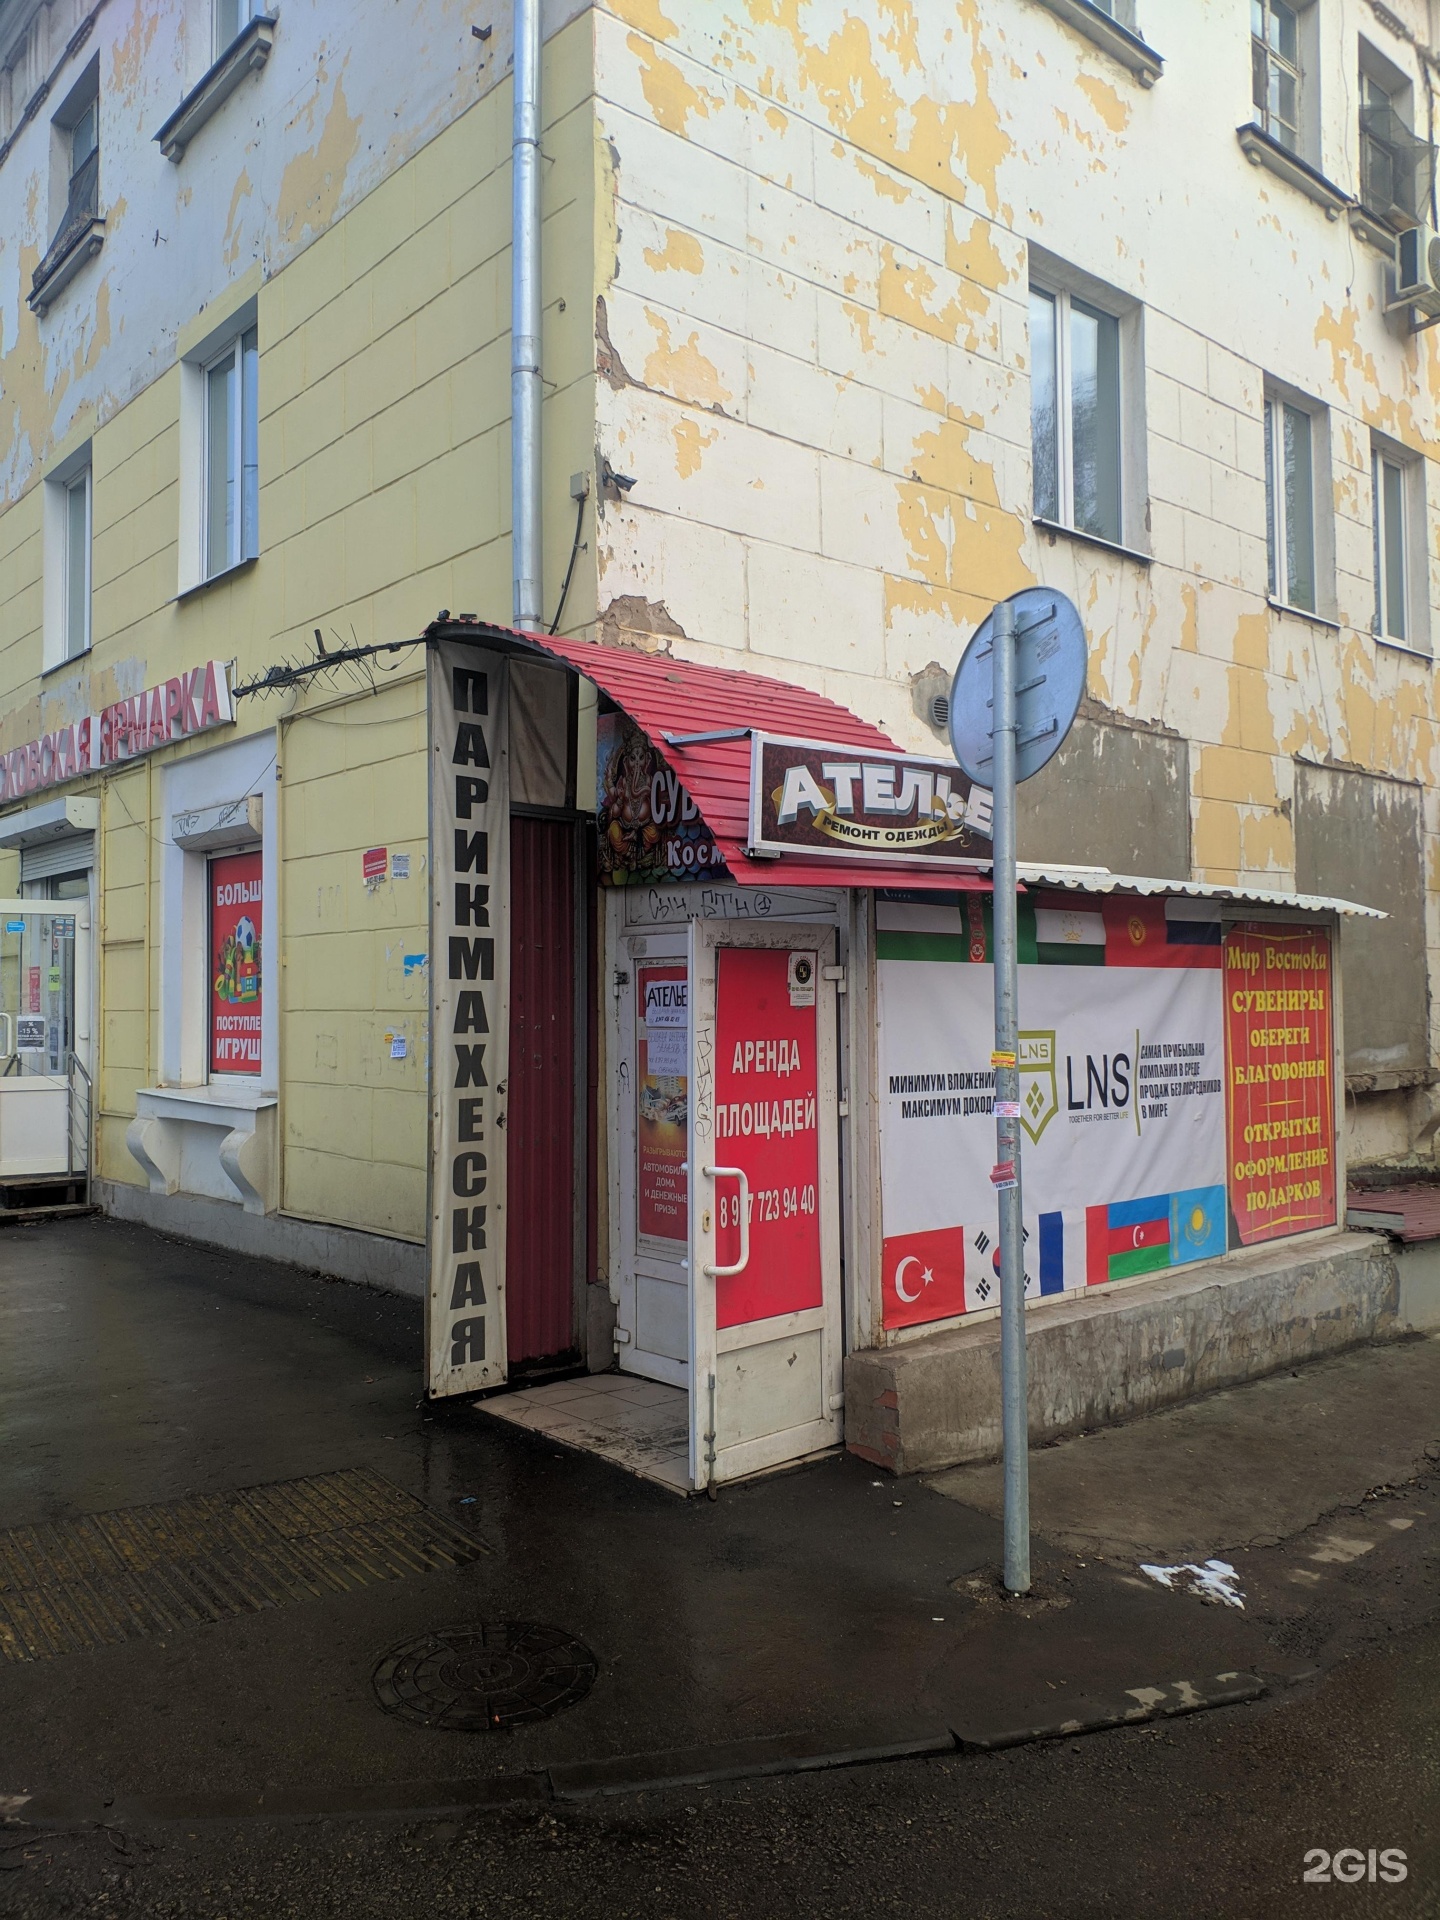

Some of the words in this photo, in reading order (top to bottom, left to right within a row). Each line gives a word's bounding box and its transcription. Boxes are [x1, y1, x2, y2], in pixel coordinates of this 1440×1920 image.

[100, 660, 220, 766] ЯРМАРКА
[777, 762, 993, 841] АТЕЛЬЕ
[822, 816, 880, 841] РЕМОНТ
[885, 823, 948, 843] ОДЕЖДЫ
[1227, 946, 1260, 977] Мир
[1266, 946, 1327, 971] Востока
[647, 984, 687, 1008] АТЕЛЬЕ
[1232, 989, 1324, 1013] СУВЕНИРЫ
[447, 666, 495, 1367] ПАРИКМАХЕСКАЯ
[216, 1037, 261, 1061] ИГРУШ
[1250, 1026, 1310, 1048] ОБЕРЕГИ
[732, 1039, 800, 1078] АРЕНДА
[1019, 1043, 1049, 1058] LNS
[1140, 1044, 1162, 1060] САМАЯ
[1163, 1042, 1205, 1058] ПРИБЫЛЬНАЯ
[1066, 1053, 1130, 1111] LNS
[1139, 1063, 1178, 1079] КОМПАНИЯ
[1179, 1063, 1184, 1077] В
[1184, 1062, 1200, 1077] СРЕДЕ
[1235, 1060, 1326, 1085] БЛАГОВОНИЯ
[889, 1073, 946, 1094] МИНИМУМ
[1139, 1083, 1169, 1100] ПРОДАЖ
[716, 1090, 816, 1140] ПЛОЩАДЕЙ
[901, 1097, 961, 1119] МАКСИМУМ
[1068, 1115, 1093, 1124] TOGETHER
[1093, 1113, 1103, 1122] FOR
[1103, 1112, 1120, 1121] BETTER
[1120, 1111, 1129, 1119] LIFE
[1141, 1105, 1146, 1119] В
[1148, 1103, 1168, 1118] МИРЕ
[1244, 1116, 1321, 1144] ОТКРЫТКИ
[1234, 1148, 1328, 1181] ОФОРМЛЕНИЕ
[655, 1177, 676, 1188] ДОМА
[644, 1188, 650, 1198] И
[651, 1189, 688, 1204] ДЕНЕЖНЫЕ
[720, 1196, 728, 1229] 8
[731, 1192, 754, 1228] 97
[757, 1189, 780, 1222] 723
[783, 1186, 798, 1219] 94
[800, 1184, 815, 1215] 40
[1247, 1179, 1321, 1212] ПОДАРКОВ
[654, 1203, 678, 1215] ПРИЗЫ
